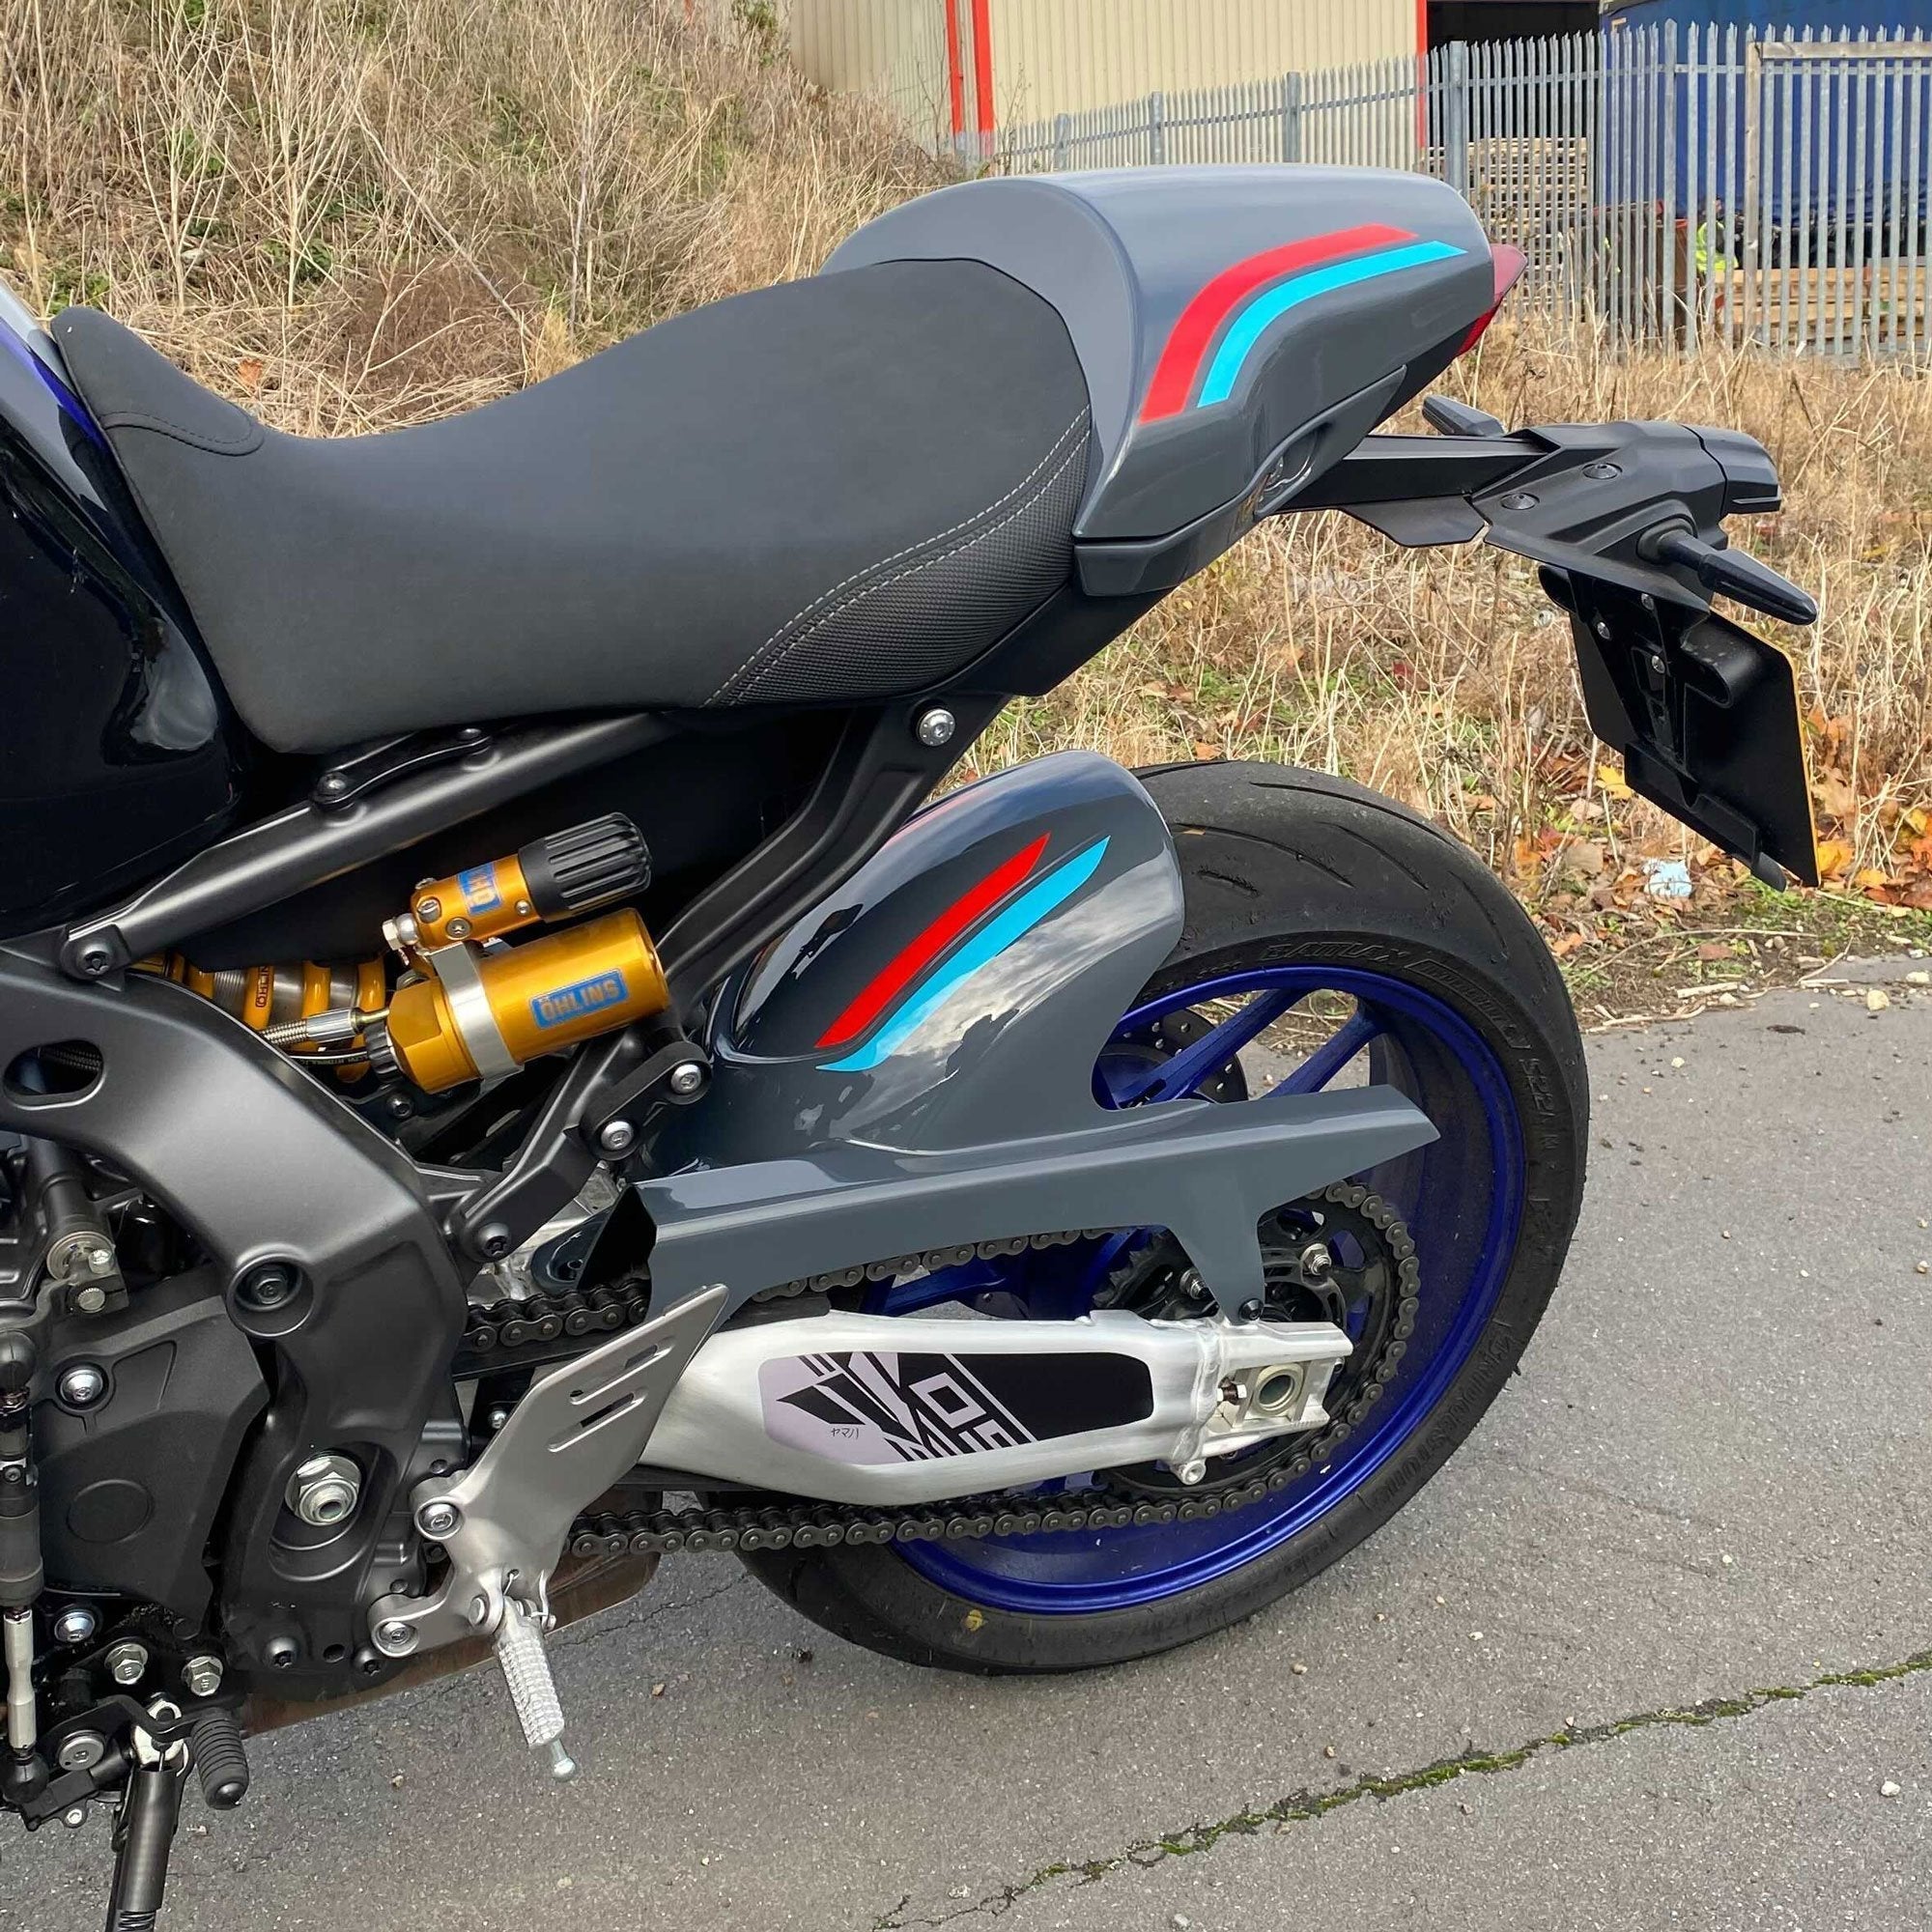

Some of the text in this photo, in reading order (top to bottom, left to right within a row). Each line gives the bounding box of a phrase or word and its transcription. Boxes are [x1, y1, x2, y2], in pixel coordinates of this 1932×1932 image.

[257, 966, 270, 1006] ÖHLIN
[541, 979, 620, 1021] ÖHLINS
[831, 1427, 860, 1440] ヤマハ
